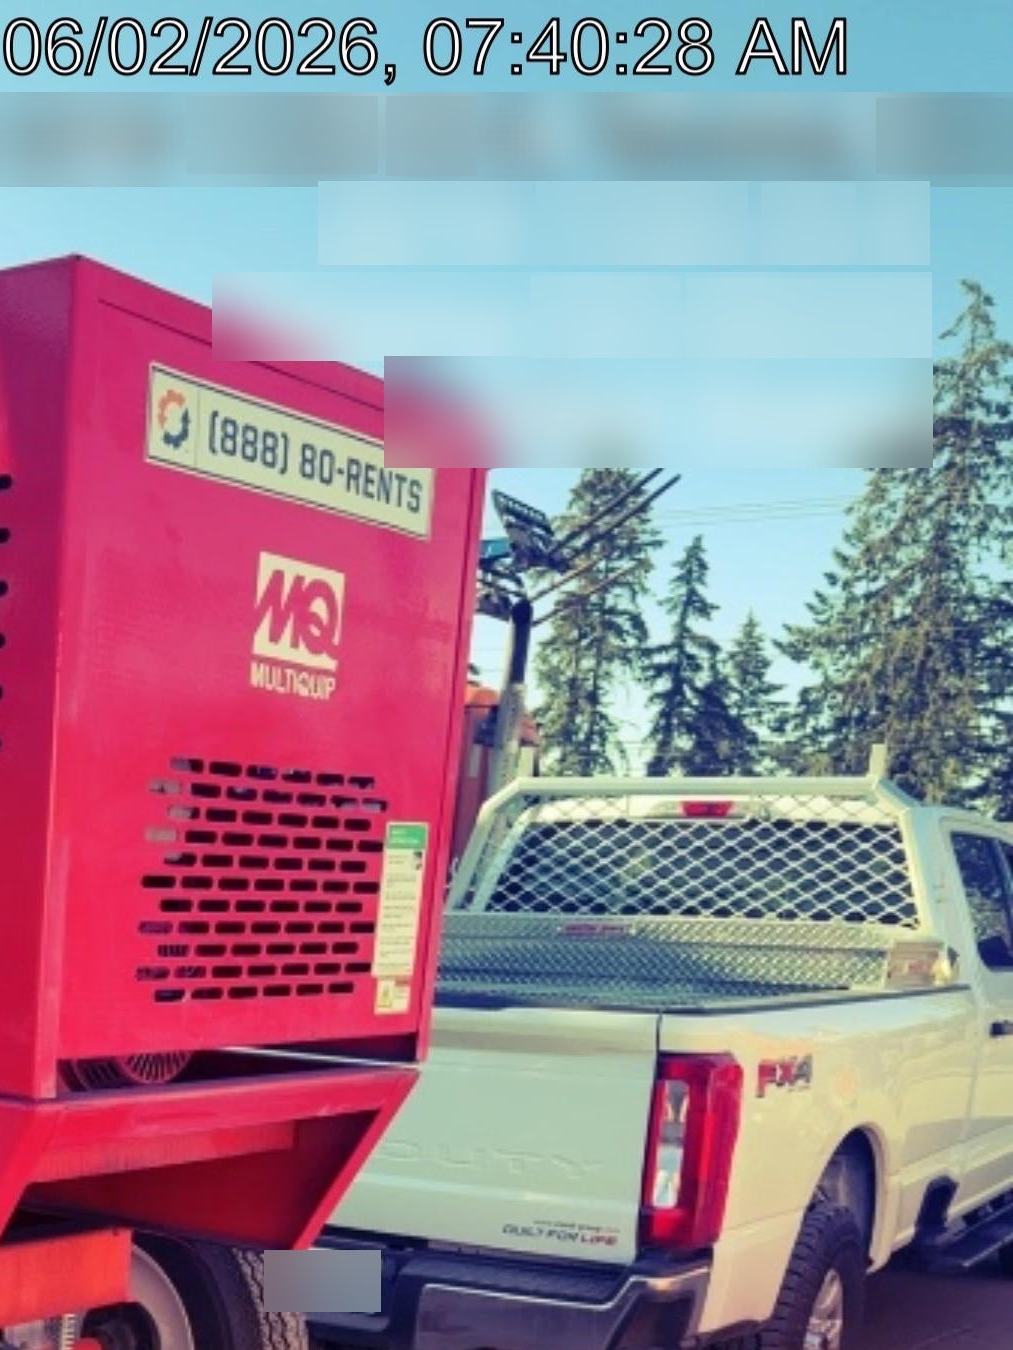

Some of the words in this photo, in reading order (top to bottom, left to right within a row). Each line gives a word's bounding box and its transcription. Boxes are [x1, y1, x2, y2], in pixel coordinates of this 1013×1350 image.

[208, 409, 290, 476] (888)
[299, 442, 424, 515] 80-RENTS
[253, 568, 340, 661] MQ
[250, 660, 336, 701] MULTIQUIP
[755, 1054, 812, 1099] FX4
